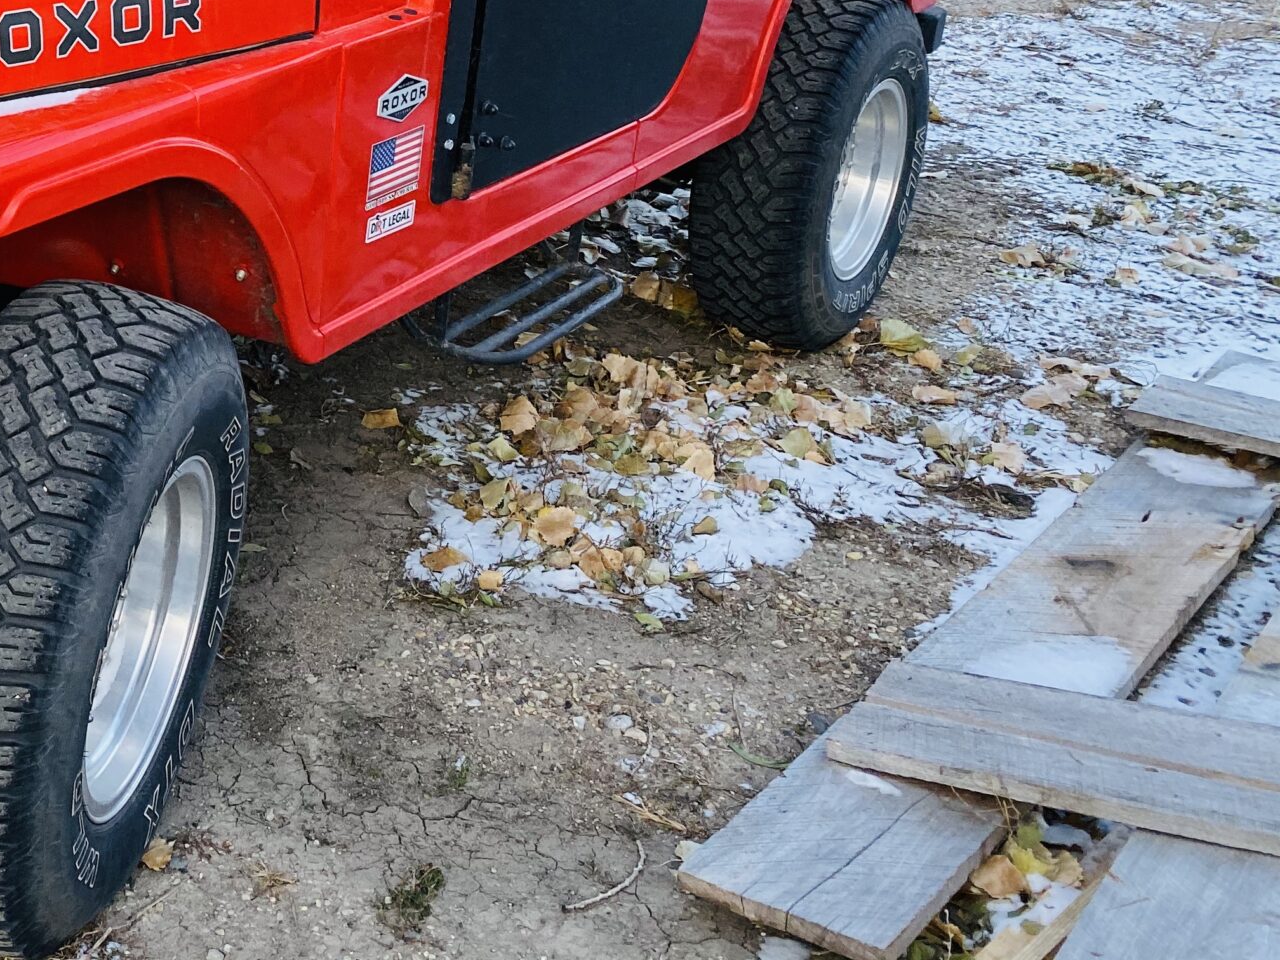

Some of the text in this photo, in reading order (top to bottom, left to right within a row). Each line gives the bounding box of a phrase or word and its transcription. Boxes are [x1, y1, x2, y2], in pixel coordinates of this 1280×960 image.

[381, 84, 427, 114] ROXOR
[388, 208, 410, 227] LEGAL
[832, 249, 890, 314] SPIRIT
[207, 415, 246, 649] RADIAL
